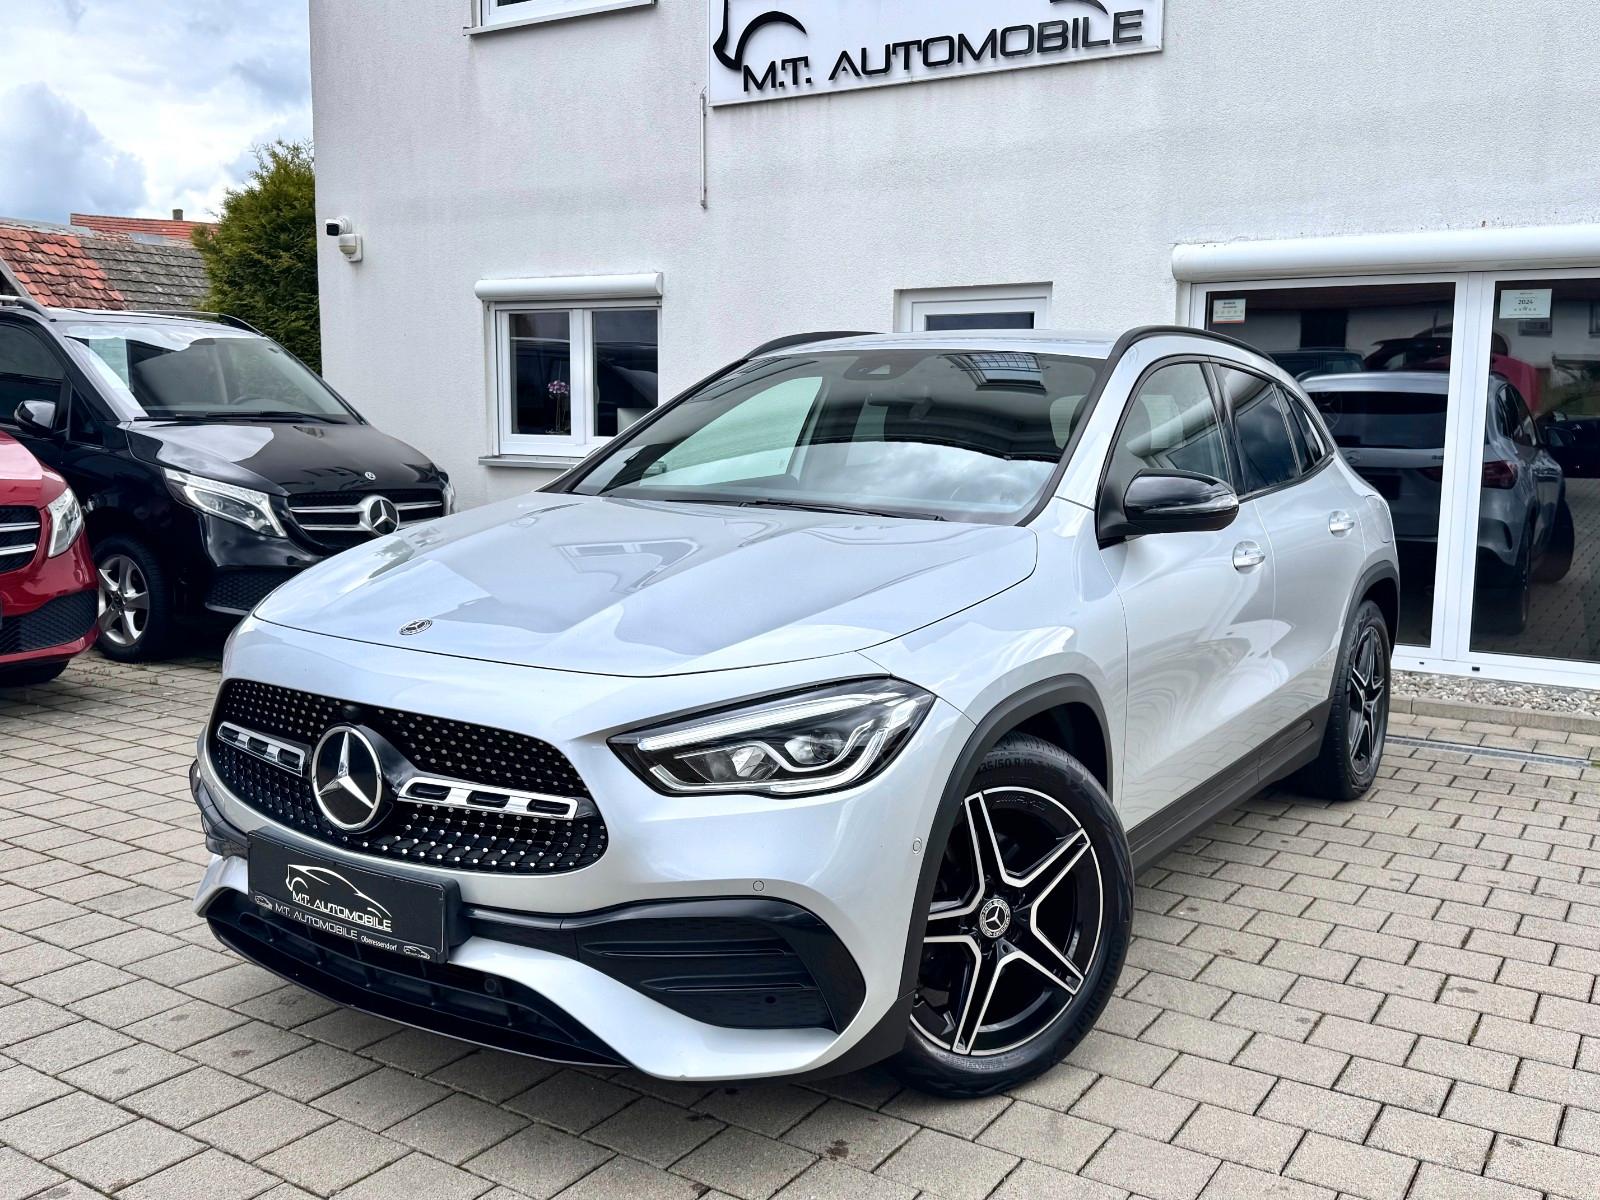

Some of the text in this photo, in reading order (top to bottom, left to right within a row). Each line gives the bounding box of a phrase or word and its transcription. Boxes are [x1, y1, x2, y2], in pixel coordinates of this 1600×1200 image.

[742, 9, 1144, 92] M.T. AUTOMOBILE
[275, 903, 291, 918] M.T.
[294, 911, 358, 940] AUTOMOBILE
[360, 935, 398, 952] Oberessendorf
[292, 890, 311, 907] M.T.
[315, 899, 392, 931] AUTOMOBILE
